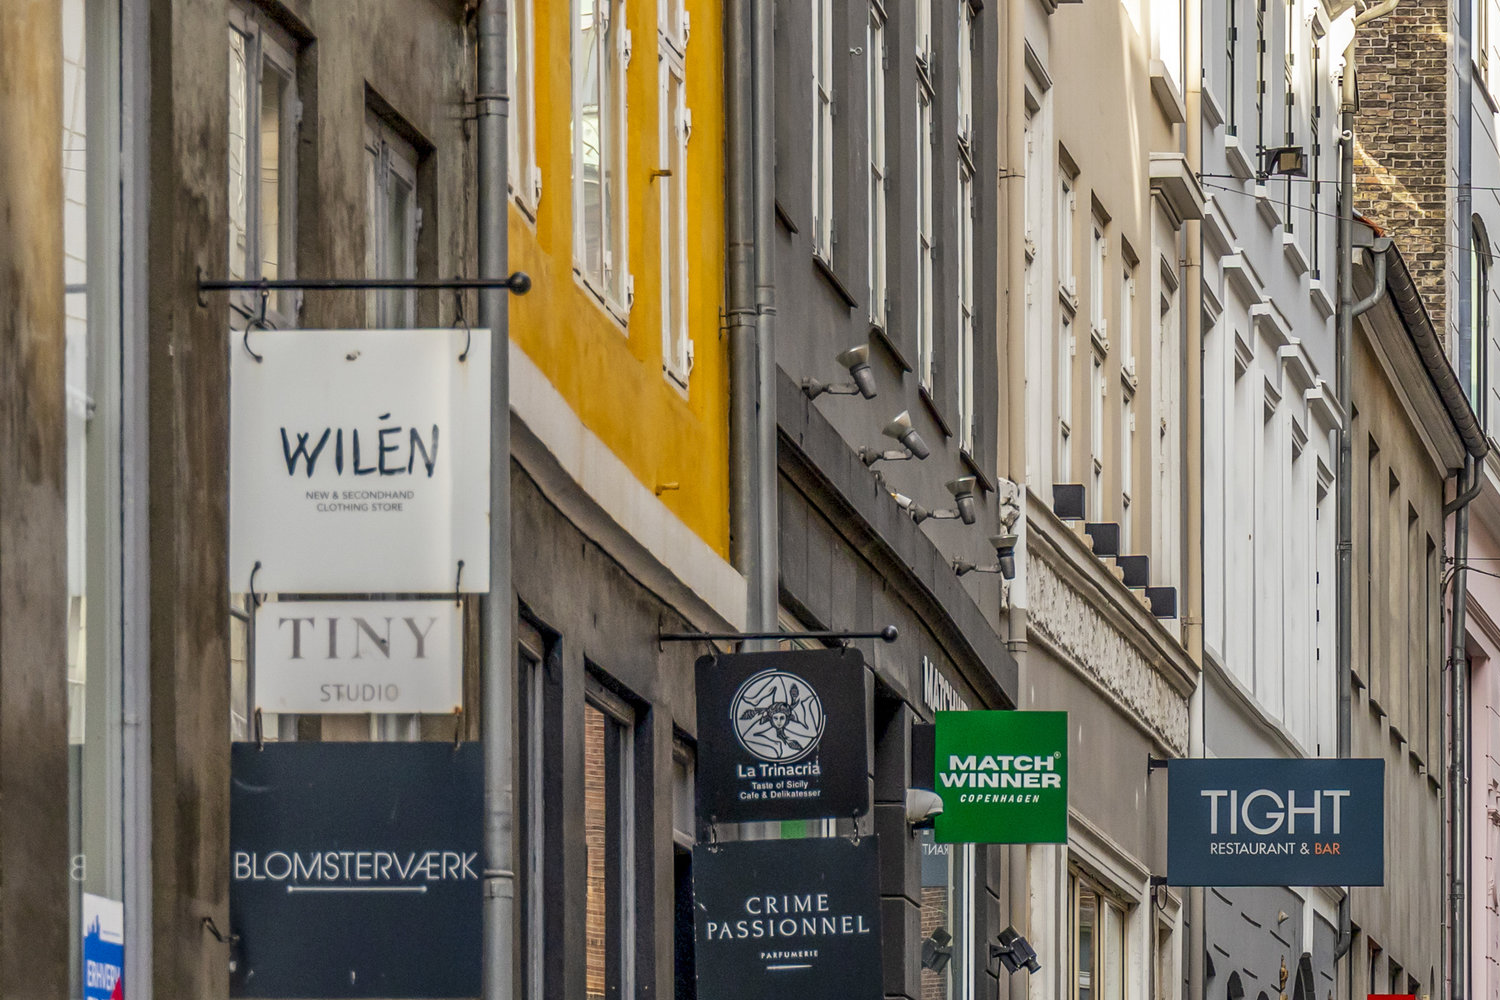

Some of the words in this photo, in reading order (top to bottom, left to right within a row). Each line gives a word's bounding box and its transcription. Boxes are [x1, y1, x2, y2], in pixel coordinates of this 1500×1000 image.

[280, 413, 440, 479] WILÉN
[306, 491, 329, 500] NEW
[332, 491, 339, 500] &
[342, 491, 415, 500] SECONDHAND
[316, 503, 368, 512] CLOTHING
[371, 503, 403, 512] STORE
[278, 617, 438, 661] TINY
[320, 683, 399, 702] STUDIO
[738, 764, 756, 777] La
[759, 762, 820, 777] Trinacria
[950, 755, 1054, 771] MATCH
[752, 782, 773, 790] Taste
[776, 781, 784, 789] of
[786, 780, 808, 789] Sicily
[939, 772, 1062, 788] WINNER
[740, 791, 759, 800] Cafe
[762, 791, 768, 799] &
[960, 794, 1040, 803] COPENHAGEN
[1200, 789, 1350, 835] TIGHT
[1210, 842, 1296, 855] RESTAURANT
[1300, 842, 1310, 855] &
[1315, 842, 1340, 855] BAR
[234, 852, 479, 880] BLOMSTERVÆRK
[746, 894, 829, 915] CRIME
[706, 915, 870, 940] PASSIONNEL
[761, 950, 818, 959] PARFUMERIE
